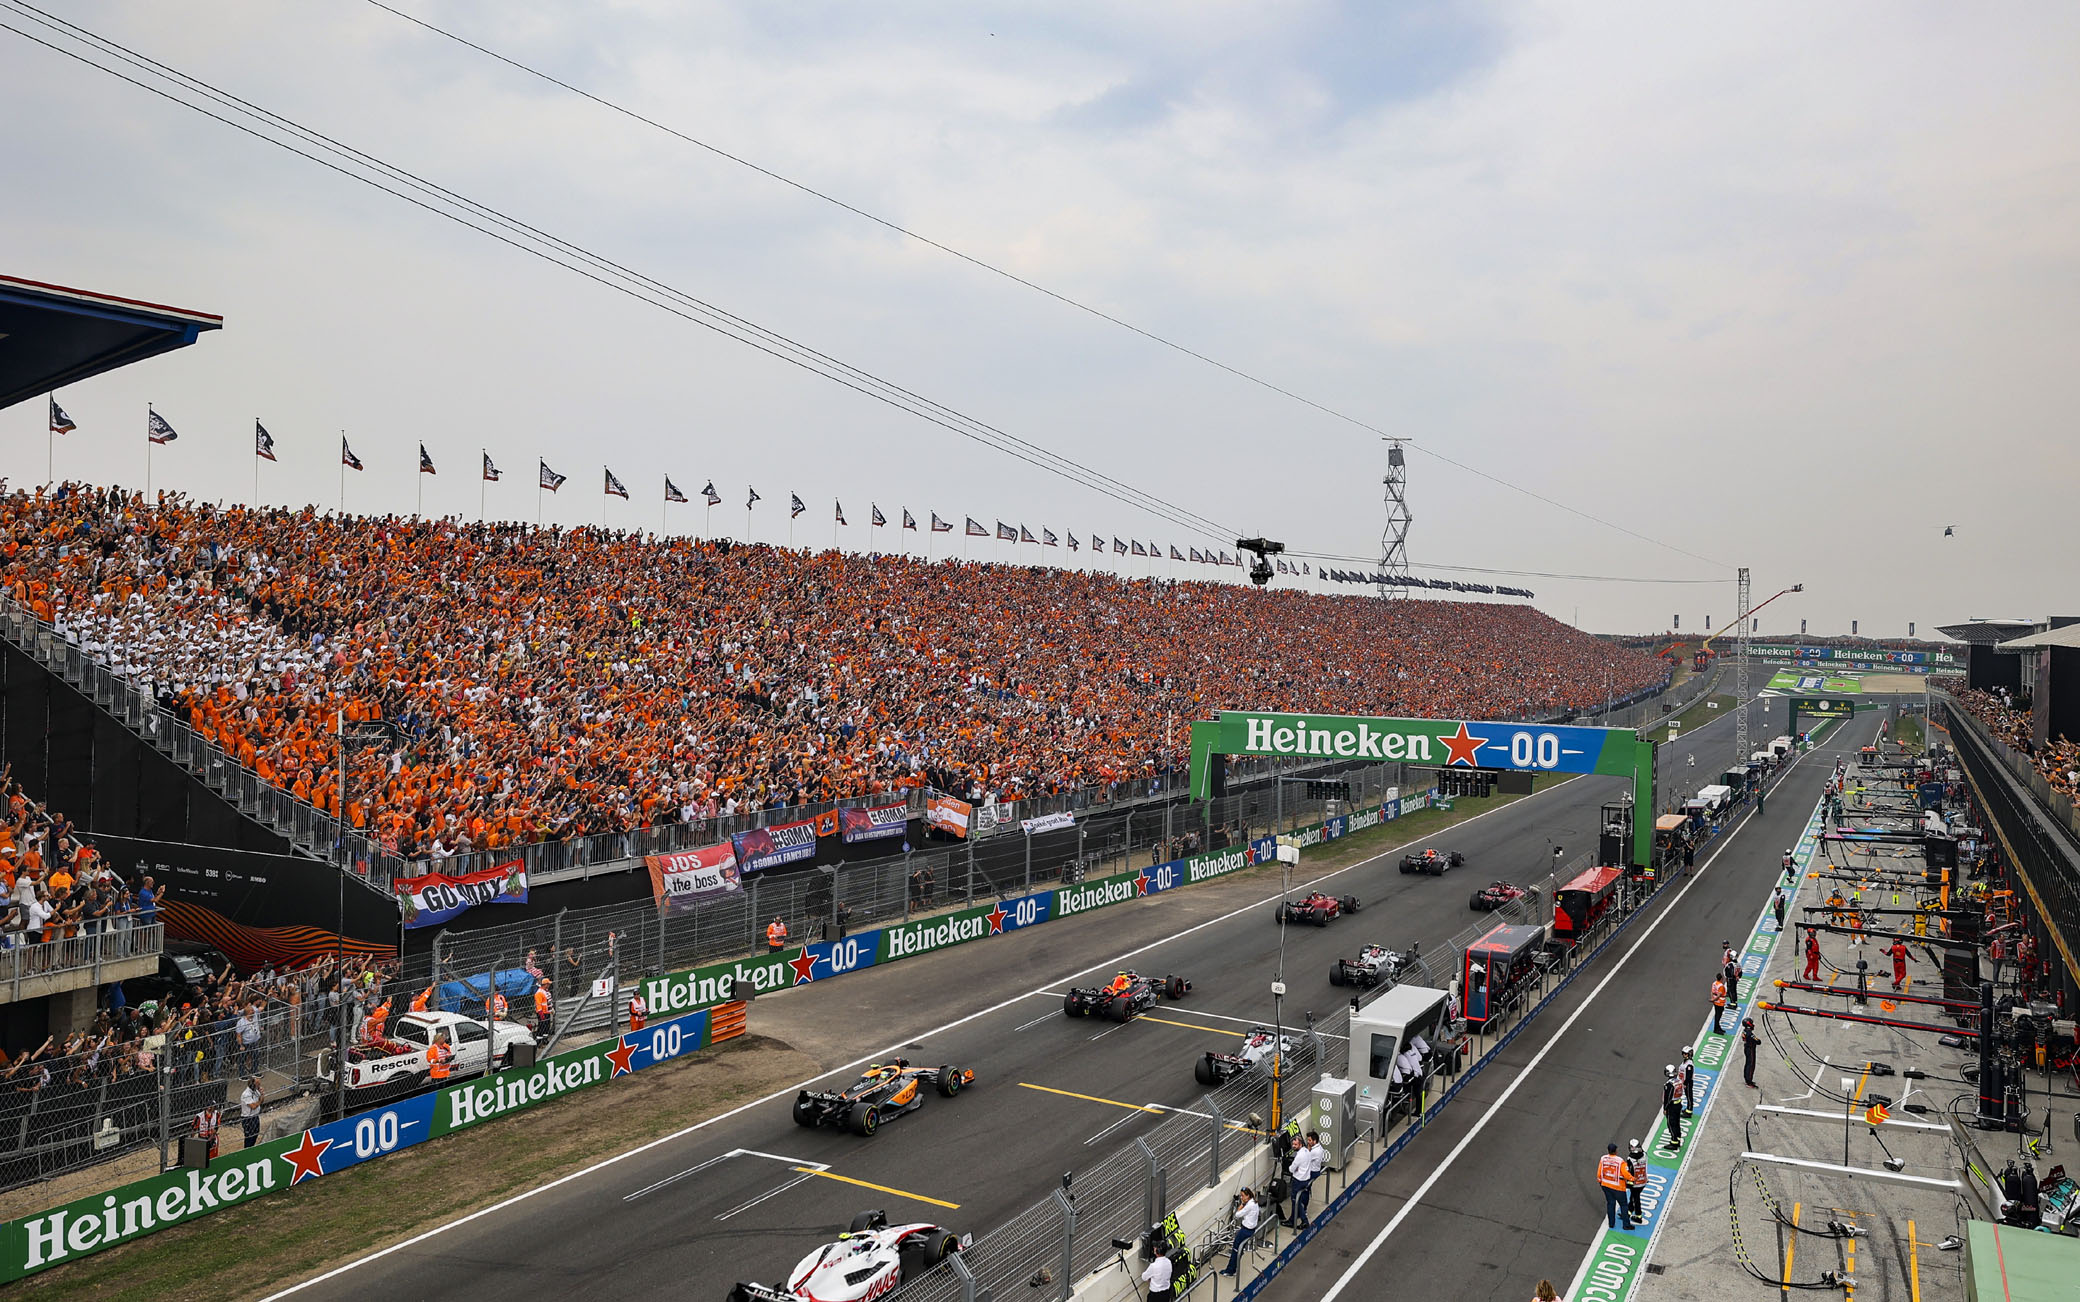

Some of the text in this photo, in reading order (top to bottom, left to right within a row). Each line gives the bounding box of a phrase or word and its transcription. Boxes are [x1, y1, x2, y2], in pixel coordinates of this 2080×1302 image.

[1834, 650, 1882, 661] Heineken
[1245, 718, 1560, 770] Heineken 0.0
[1348, 809, 1379, 833] Heineken
[1400, 796, 1426, 816] Heineken
[771, 822, 816, 849] #GOMAX
[667, 853, 703, 874] JOS
[752, 855, 783, 869] #GOMAX
[1189, 840, 1273, 882] Heineken 0.0
[421, 875, 503, 913] GO MAX
[672, 872, 719, 893] the boss
[1058, 866, 1173, 916] Heineken 0.0
[888, 898, 1037, 959] Heineken 0.0
[646, 938, 858, 1015] Heineken 0.0
[371, 1057, 419, 1074] Rescue
[449, 1023, 682, 1129] Heineken 0.0
[23, 1110, 400, 1270] Heineken 0.0
[862, 1264, 899, 1302] HAAS
